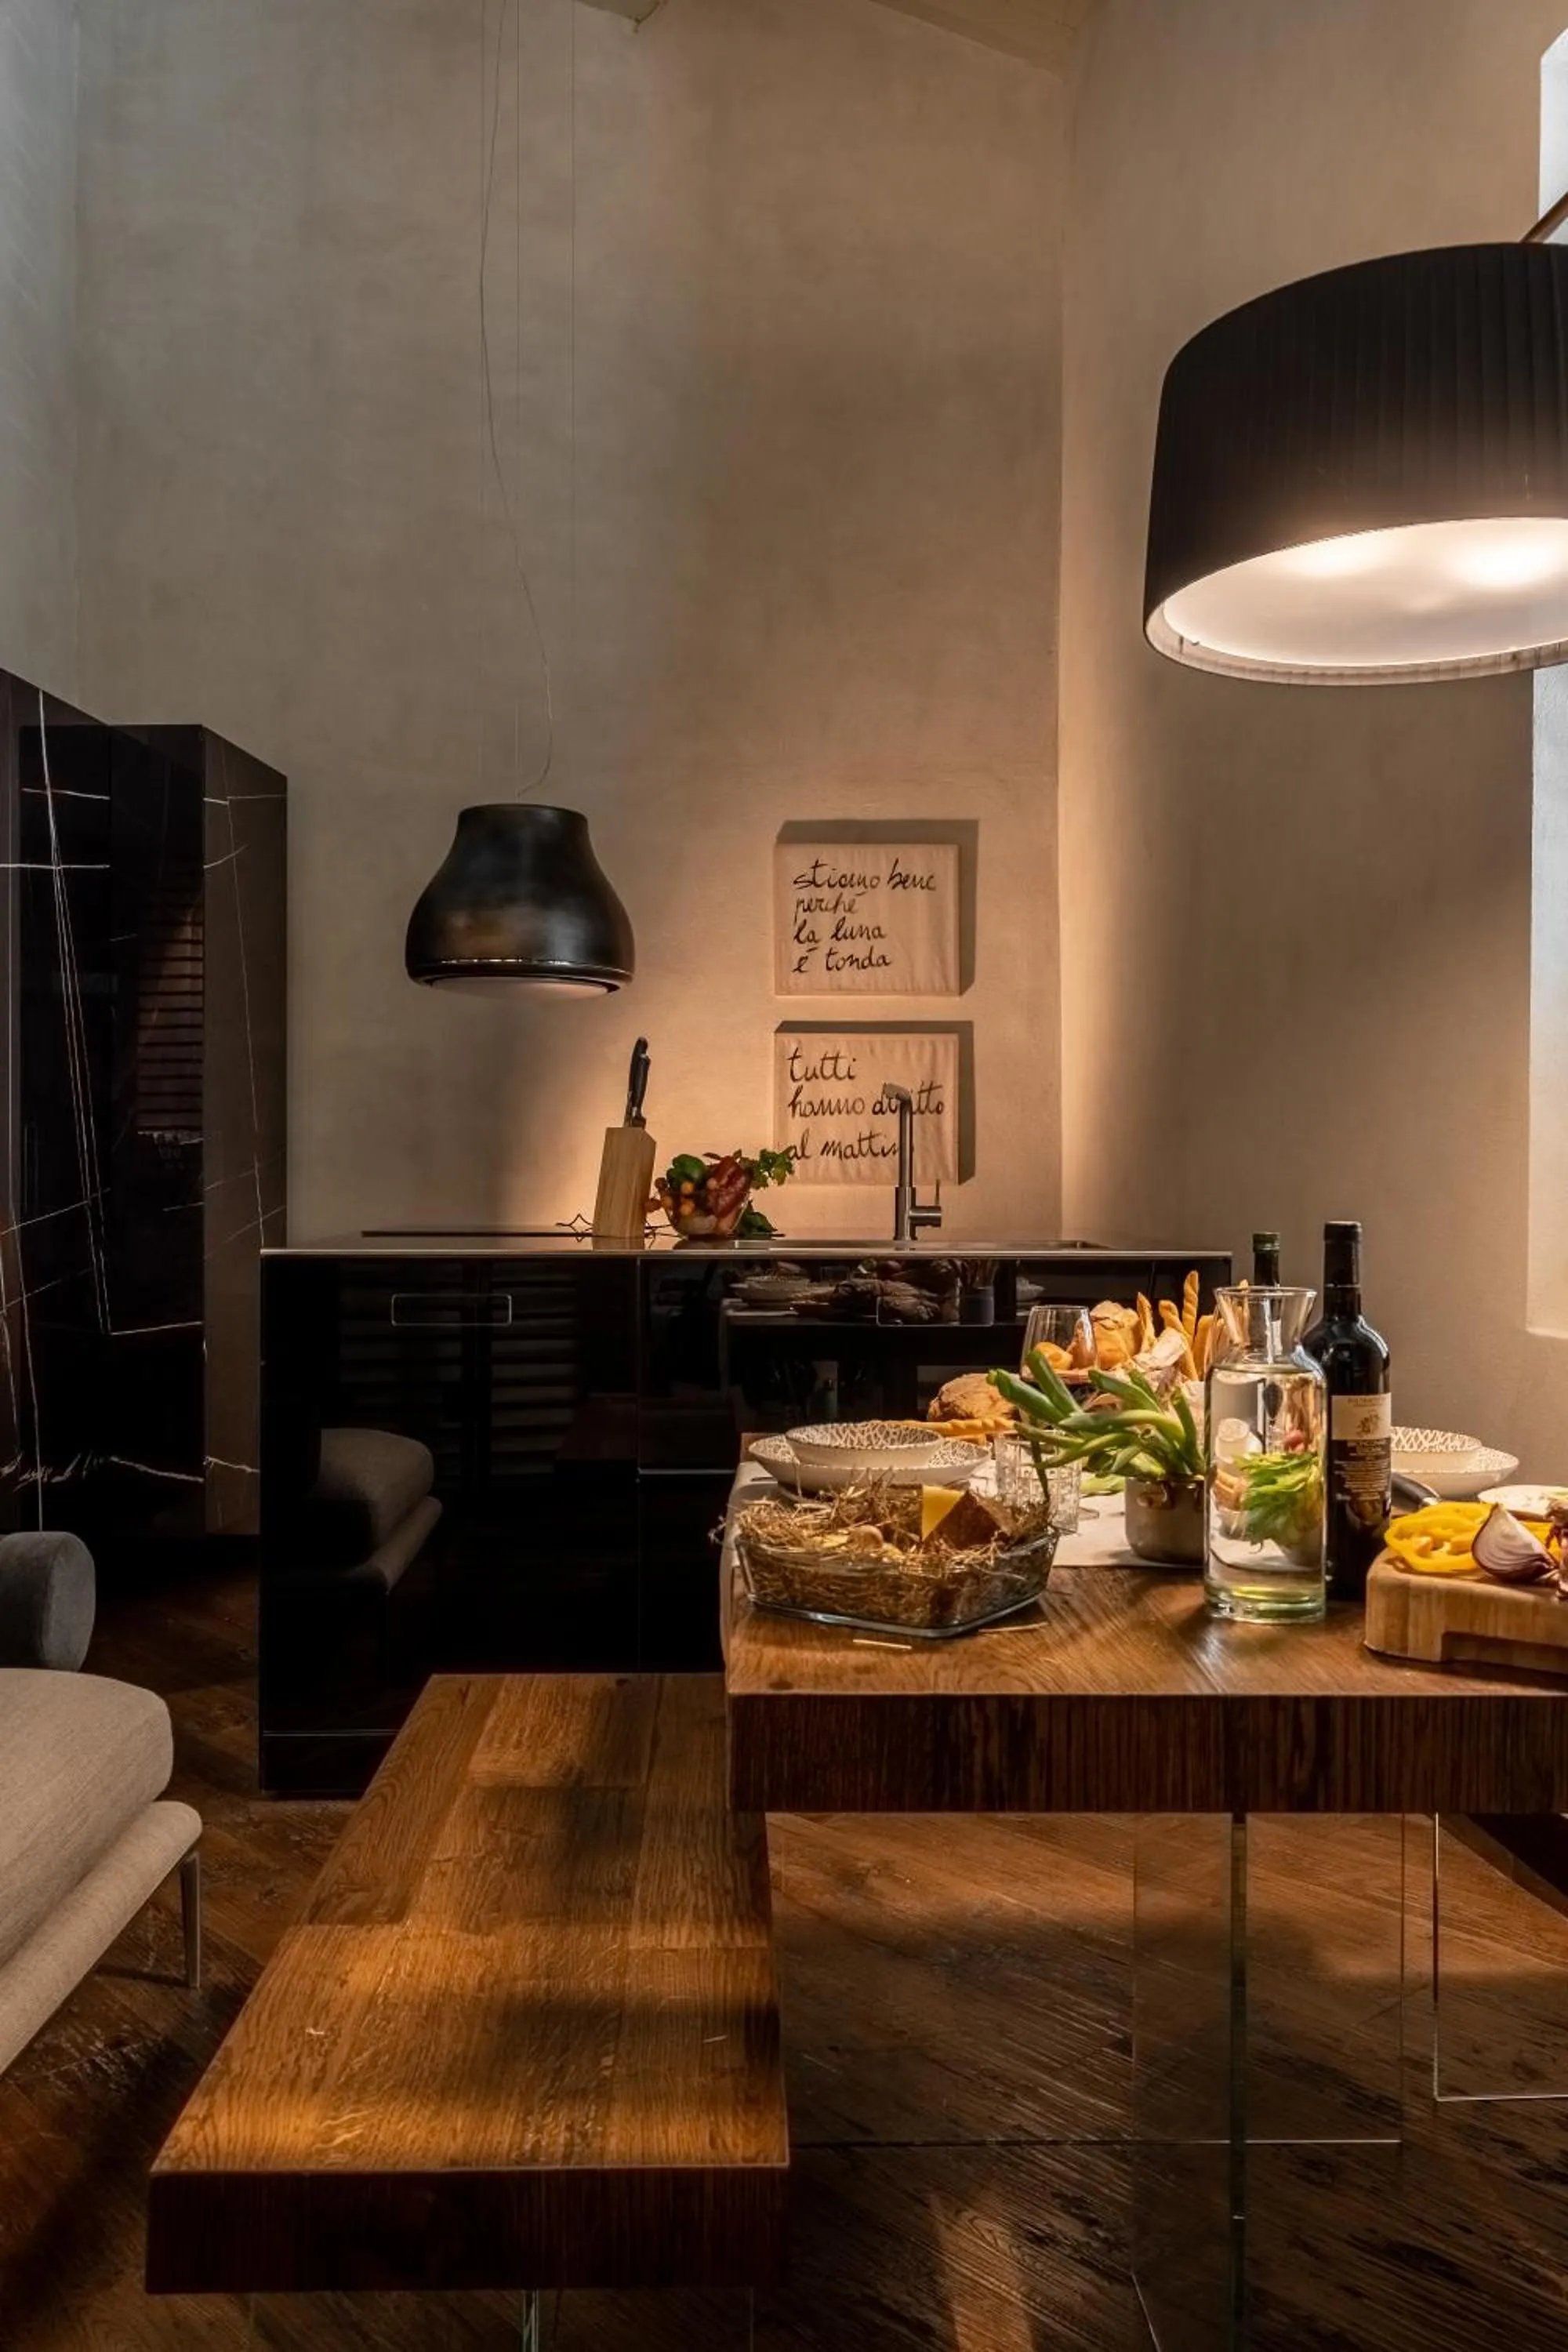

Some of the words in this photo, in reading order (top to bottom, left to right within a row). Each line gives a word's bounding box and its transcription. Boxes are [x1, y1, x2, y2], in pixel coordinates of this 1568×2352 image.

[793, 858, 880, 890] stiamo
[887, 858, 937, 891] bene
[793, 919, 822, 944] la
[830, 916, 887, 941] luna
[825, 946, 892, 971] tonda
[786, 1047, 857, 1082] tutti
[787, 1084, 865, 1118] hanno
[872, 1080, 945, 1115] ditto
[782, 1127, 811, 1160] al
